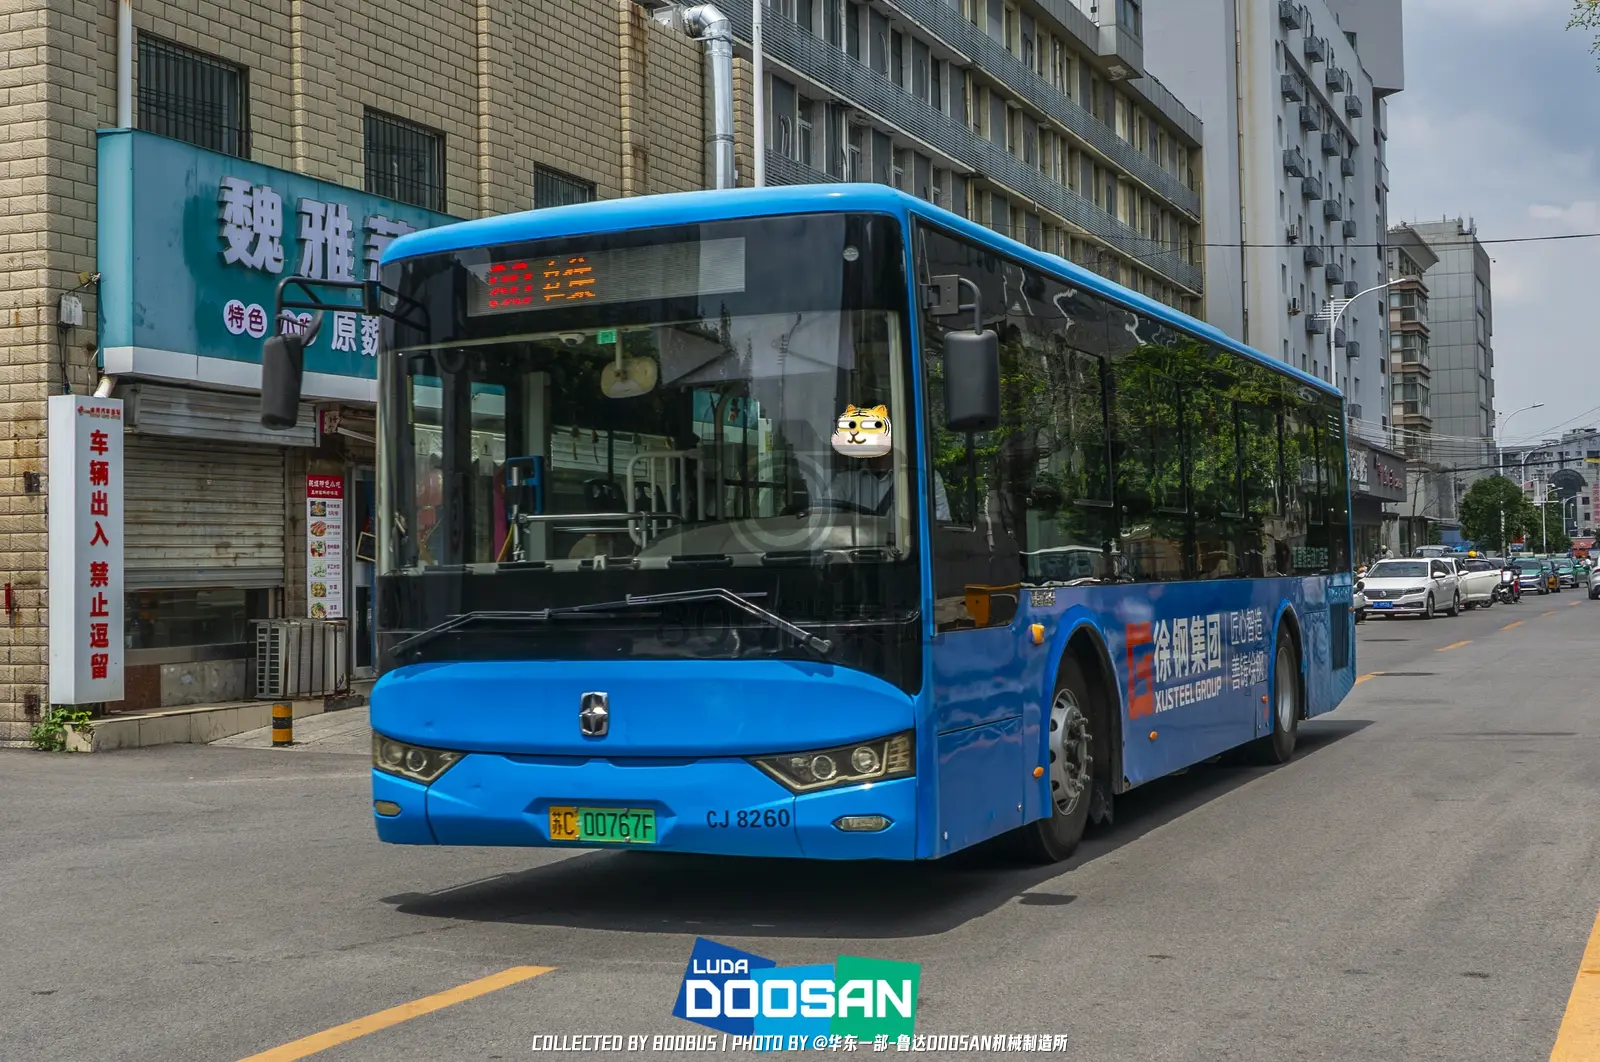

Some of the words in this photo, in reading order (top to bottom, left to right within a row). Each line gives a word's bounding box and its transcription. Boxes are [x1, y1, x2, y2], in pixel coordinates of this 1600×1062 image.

[228, 304, 264, 333] 特色
[90, 429, 109, 547] 车辆出入
[90, 562, 109, 680] 禁止逗留
[1153, 613, 1222, 683] 徐钢集团
[706, 810, 730, 829] CJ
[737, 808, 791, 828] 8260
